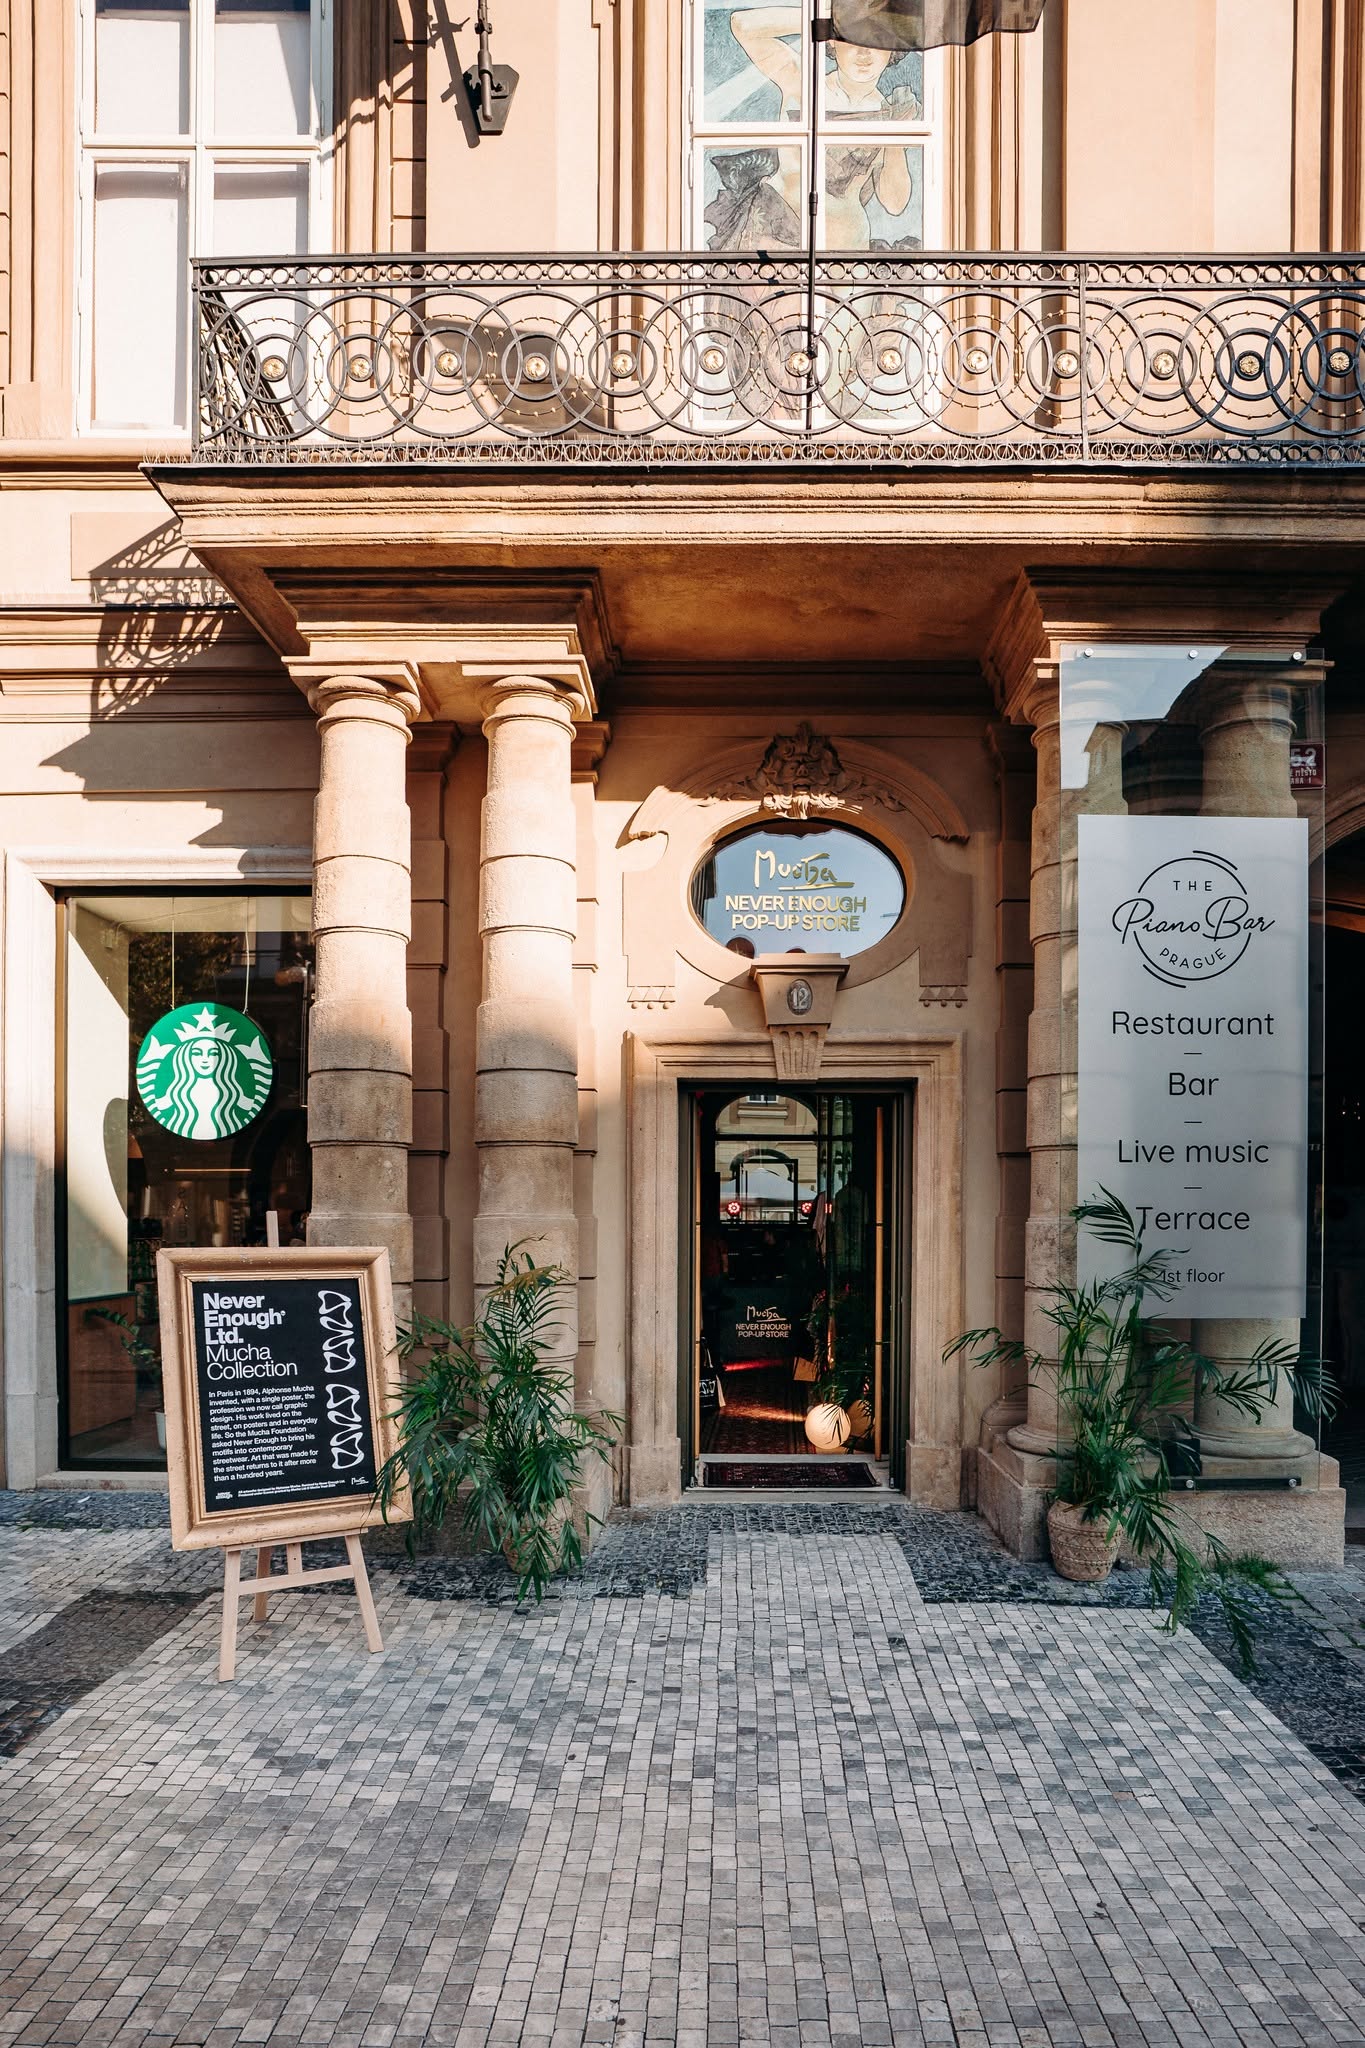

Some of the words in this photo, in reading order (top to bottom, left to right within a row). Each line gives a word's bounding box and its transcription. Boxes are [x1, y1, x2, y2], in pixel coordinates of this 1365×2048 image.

[754, 849, 855, 891] Mucha
[1174, 881, 1212, 891] THE
[726, 896, 784, 912] NEVER
[789, 896, 866, 913] ENOUGH
[732, 914, 799, 930] POP-UP
[802, 915, 860, 931] STORE
[1112, 898, 1200, 944] Piano
[1202, 896, 1275, 941] Bar
[1160, 948, 1226, 968] PRAGUE
[791, 988, 808, 1009] 12
[1112, 1011, 1274, 1035] Restaurant
[1168, 1072, 1219, 1096] Bar
[1119, 1140, 1174, 1162] Live
[1186, 1140, 1269, 1162] music
[1136, 1206, 1250, 1230] Terrace
[1187, 1269, 1225, 1282] floor
[203, 1293, 265, 1309] Never
[205, 1327, 244, 1345] Ltd.
[206, 1344, 271, 1362] Mucha
[207, 1360, 298, 1380] Collection
[210, 1407, 244, 1415] profession
[284, 1402, 307, 1410] graphic
[249, 1445, 293, 1453] contemporary
[254, 1437, 279, 1445] Enough
[265, 1470, 284, 1478] years.
